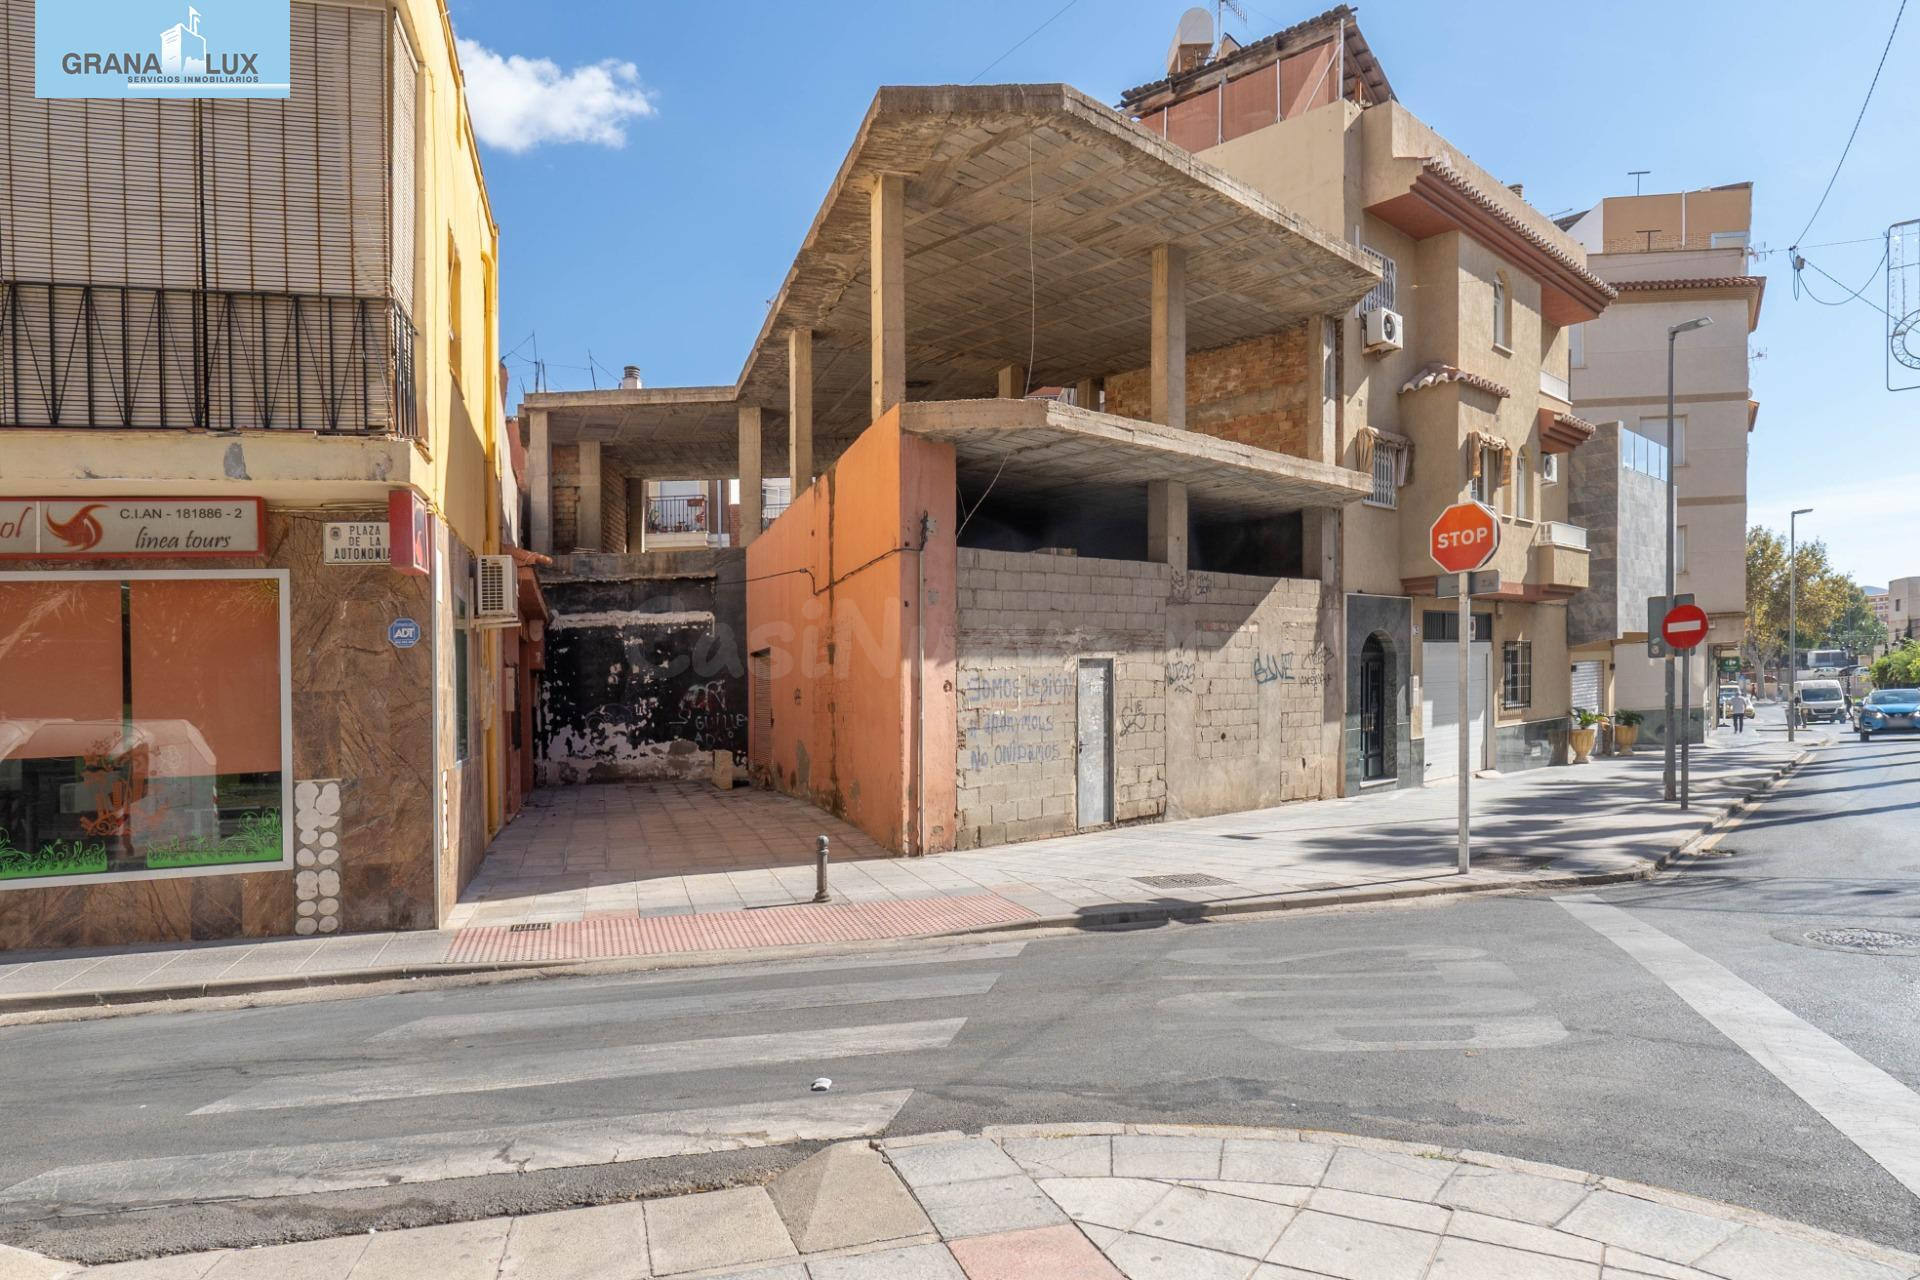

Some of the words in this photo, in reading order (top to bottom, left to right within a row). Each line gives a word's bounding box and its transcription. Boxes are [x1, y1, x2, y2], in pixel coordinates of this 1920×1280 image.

[175, 508, 222, 519] 181886
[234, 508, 242, 519] 2
[348, 525, 381, 536] PLAZA
[184, 529, 232, 549] tours
[348, 536, 361, 546] DE
[369, 536, 381, 546] LA
[1437, 527, 1489, 549] STOP
[393, 627, 415, 638] ADT
